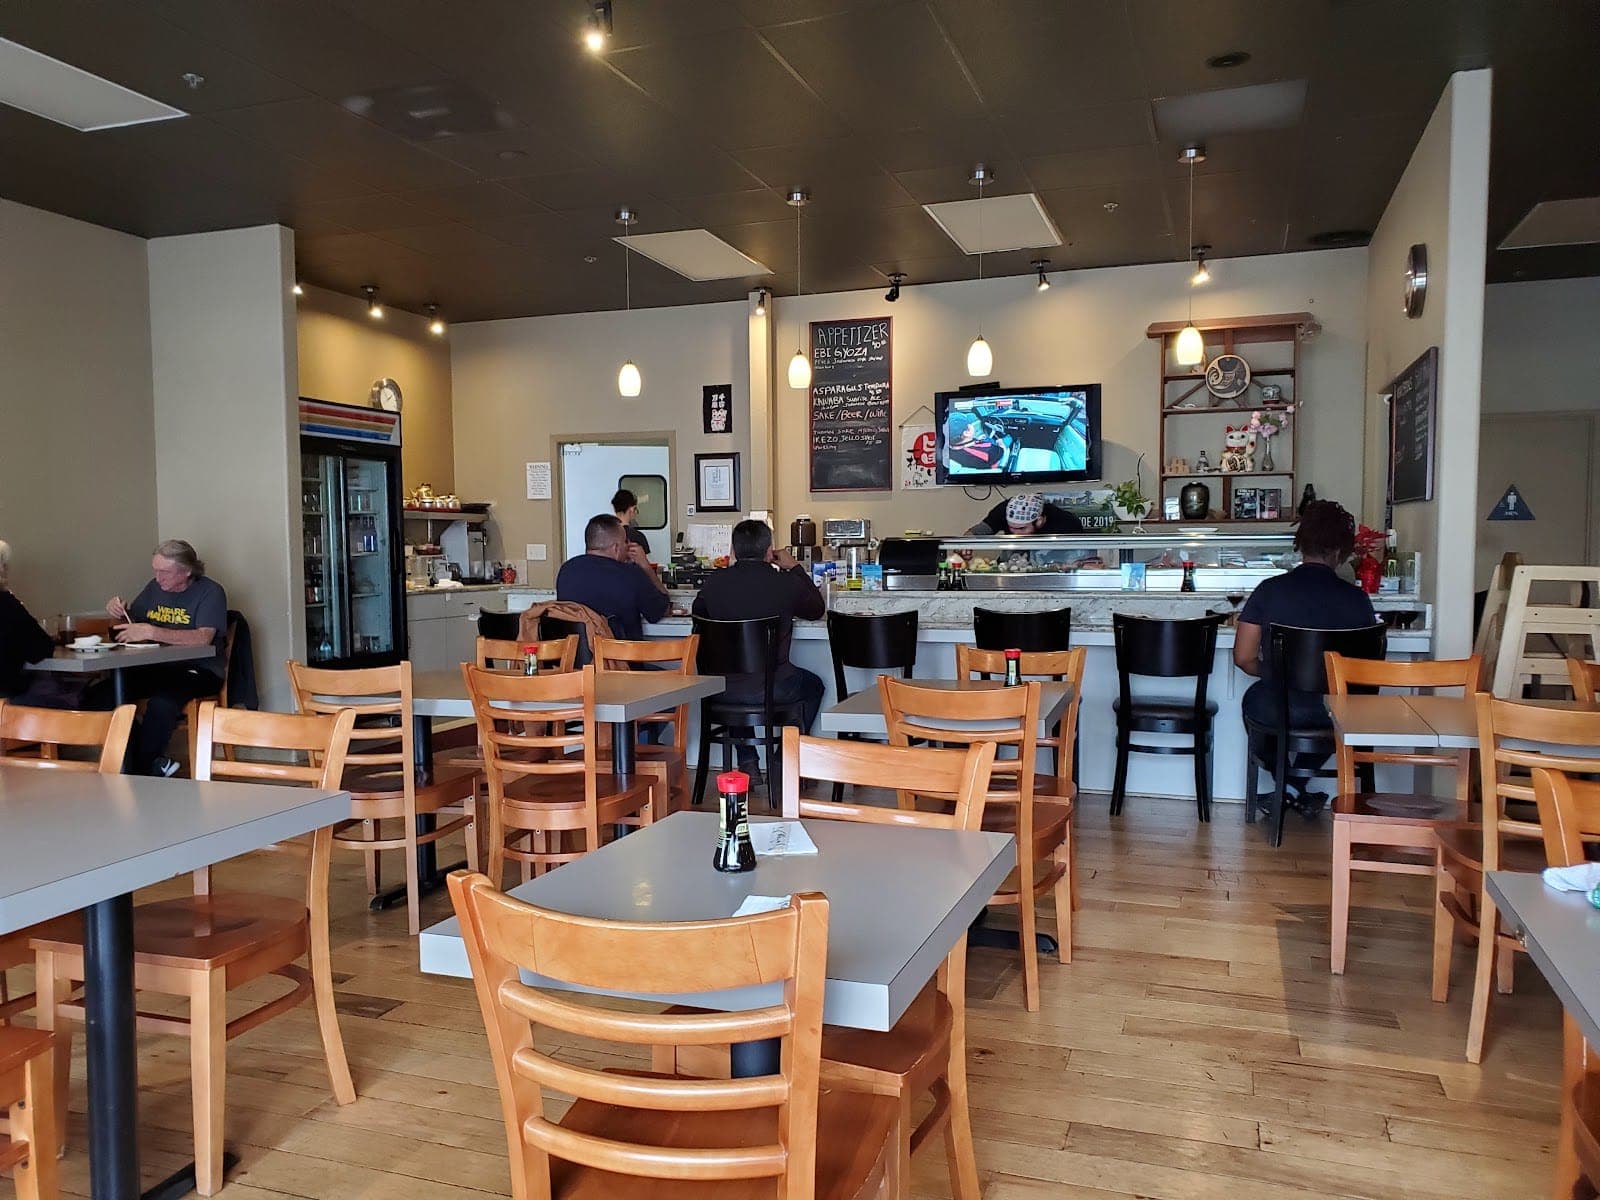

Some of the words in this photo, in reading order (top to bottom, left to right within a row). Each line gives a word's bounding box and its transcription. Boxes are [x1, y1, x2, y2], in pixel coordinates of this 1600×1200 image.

[818, 323, 889, 346] APPETIZER
[814, 347, 832, 358] EBI
[834, 346, 868, 359] GYOZA
[813, 384, 863, 395] ASPARAGUS
